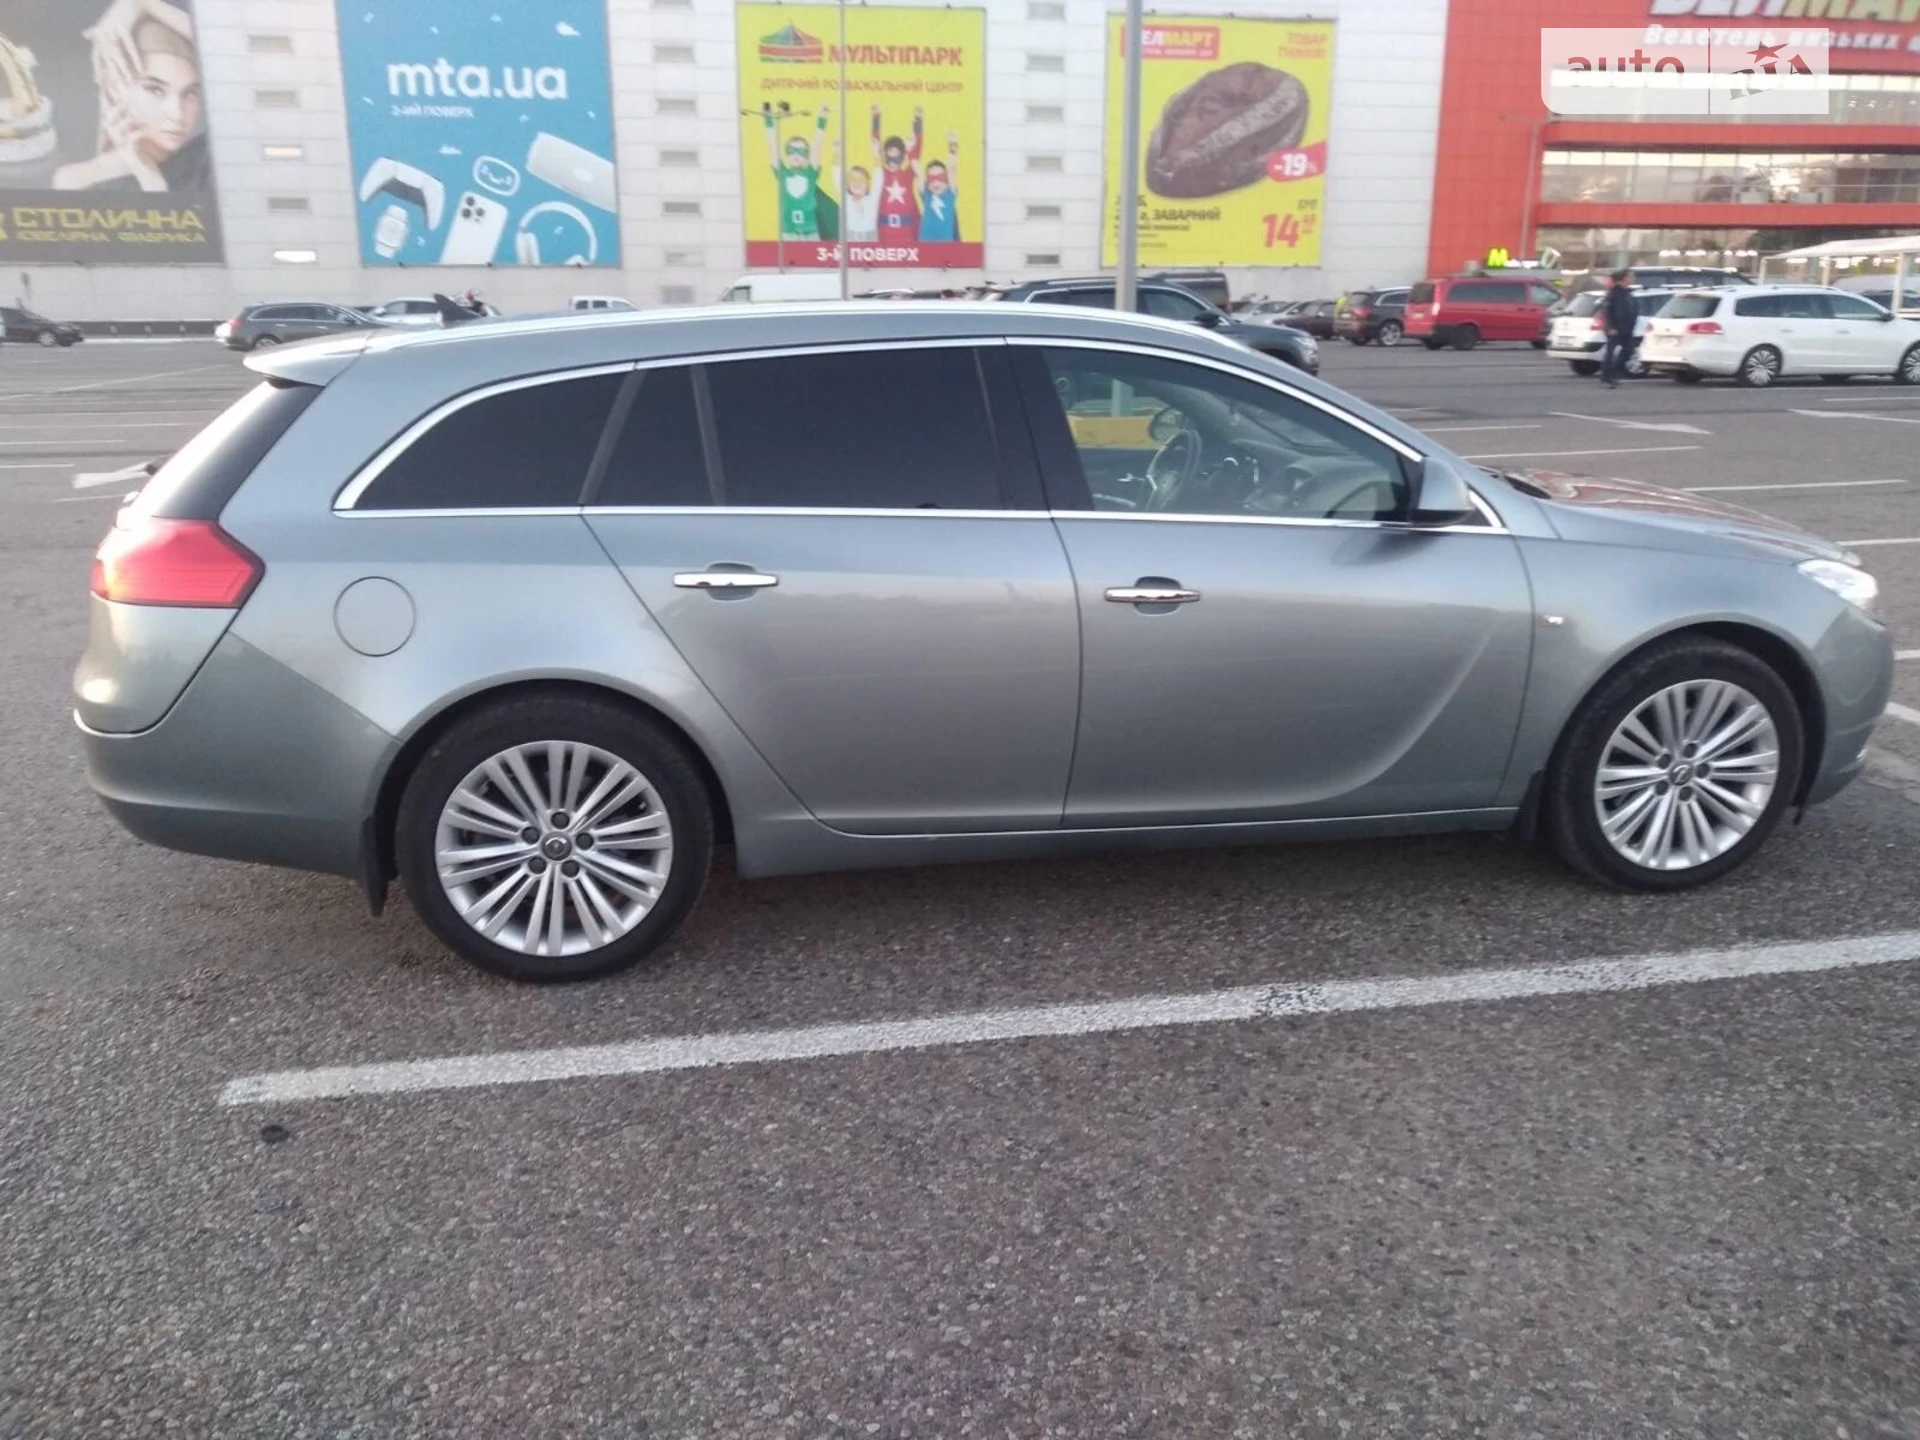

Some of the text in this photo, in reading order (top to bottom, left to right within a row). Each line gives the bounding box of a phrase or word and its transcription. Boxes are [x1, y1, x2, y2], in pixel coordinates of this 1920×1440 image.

[1140, 30, 1214, 47] ЕЛМАРТ
[1644, 23, 1777, 47] Велетень
[1786, 30, 1900, 50] низьких
[828, 44, 963, 66] МУЛЬТІПАРК
[387, 57, 568, 100] mta.ua
[12, 206, 205, 230] СТОЛИЧНА
[1262, 213, 1300, 249] 14
[849, 247, 919, 262] ПОВЕРХ
